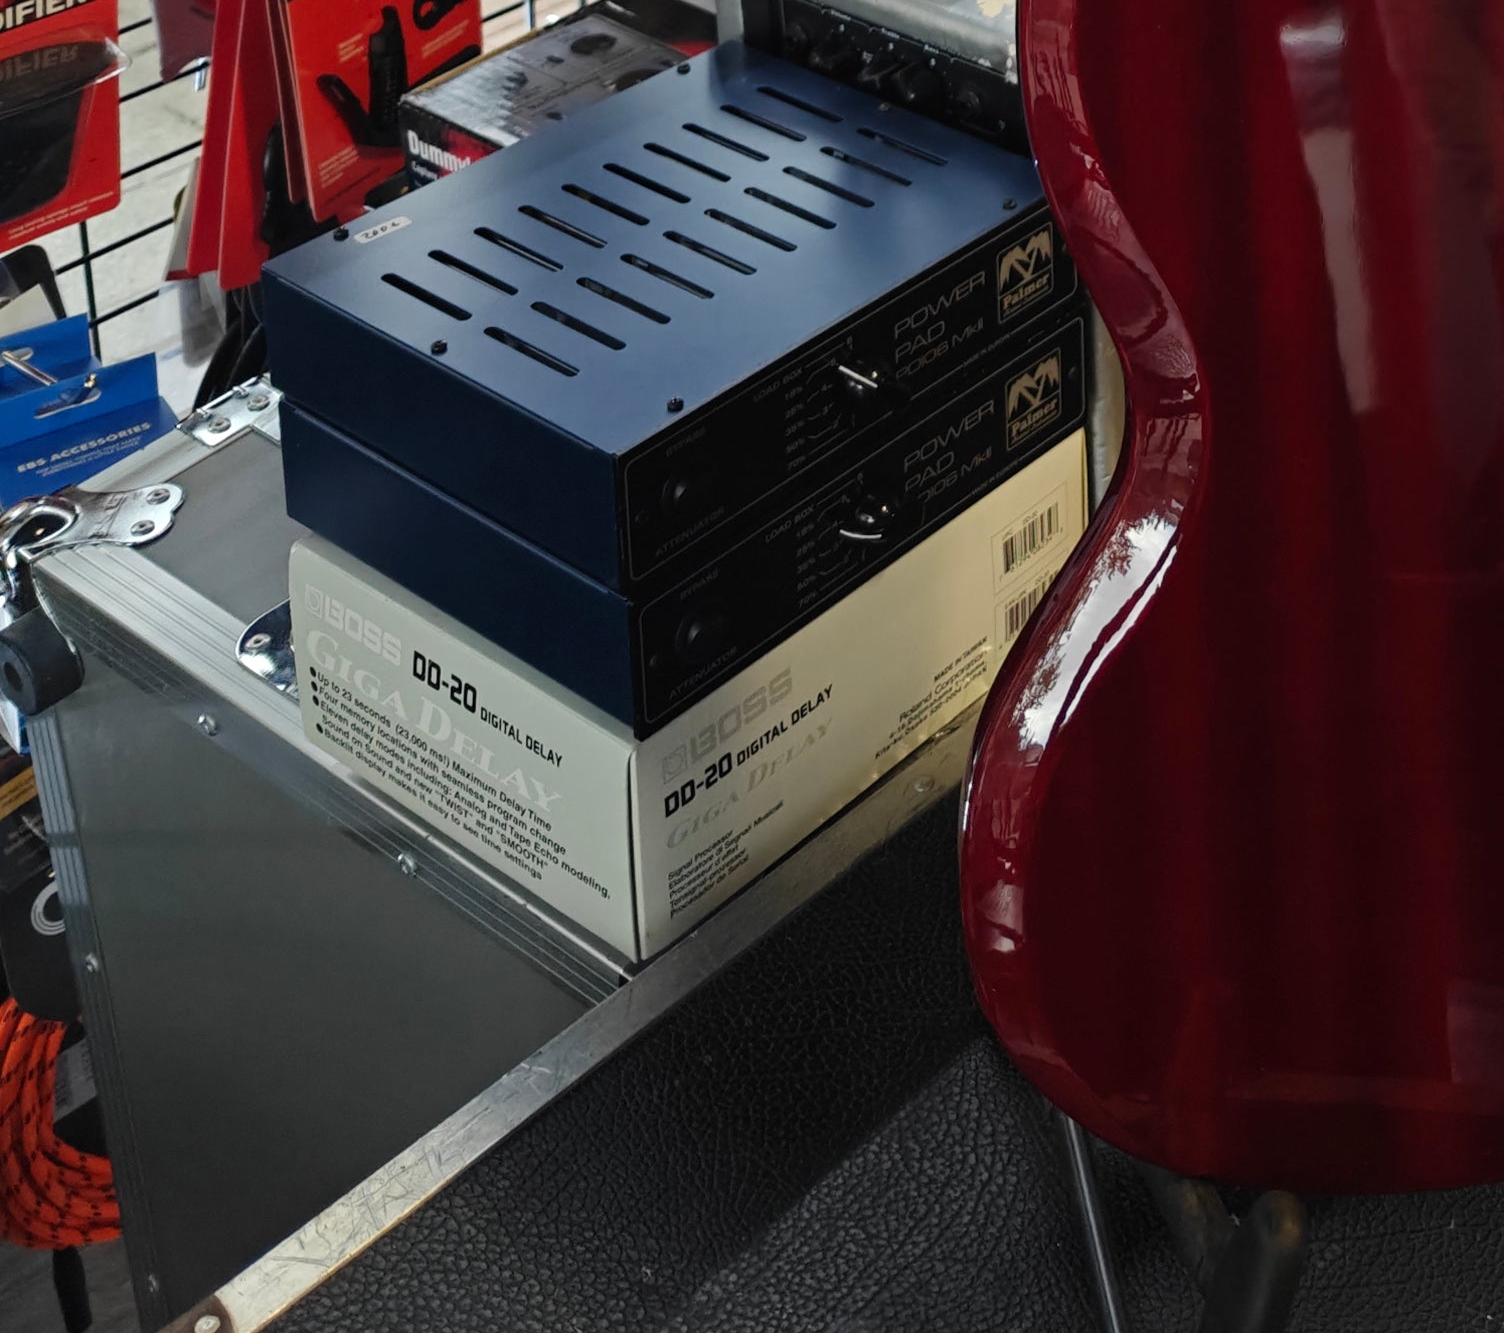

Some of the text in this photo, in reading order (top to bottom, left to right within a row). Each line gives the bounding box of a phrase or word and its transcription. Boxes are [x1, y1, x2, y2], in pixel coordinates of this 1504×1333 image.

[895, 270, 985, 339] POWER
[1002, 273, 1050, 311] Palmer
[896, 320, 945, 364] PAD
[17, 459, 47, 473] EBS
[50, 421, 152, 462] ACCESSORIES
[904, 399, 994, 473] POWER
[1010, 398, 1058, 438] Palmer
[905, 450, 955, 492] PAD
[324, 594, 402, 666] BOSS
[306, 629, 562, 811] GIGA DELAY
[413, 650, 563, 768] DD-20 DIGITAL DELAY
[664, 683, 833, 818] DD-20 DIGITAL DELAY
[690, 667, 793, 764] BOSS
[317, 672, 330, 687] Up
[331, 682, 340, 694] to
[341, 688, 352, 702] 23
[354, 698, 391, 728] seconds
[452, 760, 497, 798] Maximum
[500, 791, 526, 816] Delay
[527, 808, 552, 832] Time
[319, 686, 567, 855] Four memory locations with seamless program change
[322, 714, 351, 740] Sound
[351, 736, 363, 749] on
[365, 743, 394, 769] Sound
[395, 765, 412, 782] and
[413, 778, 433, 795] new
[475, 818, 494, 836] and
[320, 700, 611, 900] Eleven delay modes including: Analog and Tape Echo modeling,
[323, 728, 354, 754] Backlit
[355, 751, 387, 778] display
[388, 773, 418, 798] makes
[427, 799, 450, 820] easy
[462, 822, 479, 838] see
[481, 831, 502, 854] time
[504, 849, 543, 881] settings
[668, 857, 693, 882] Signal
